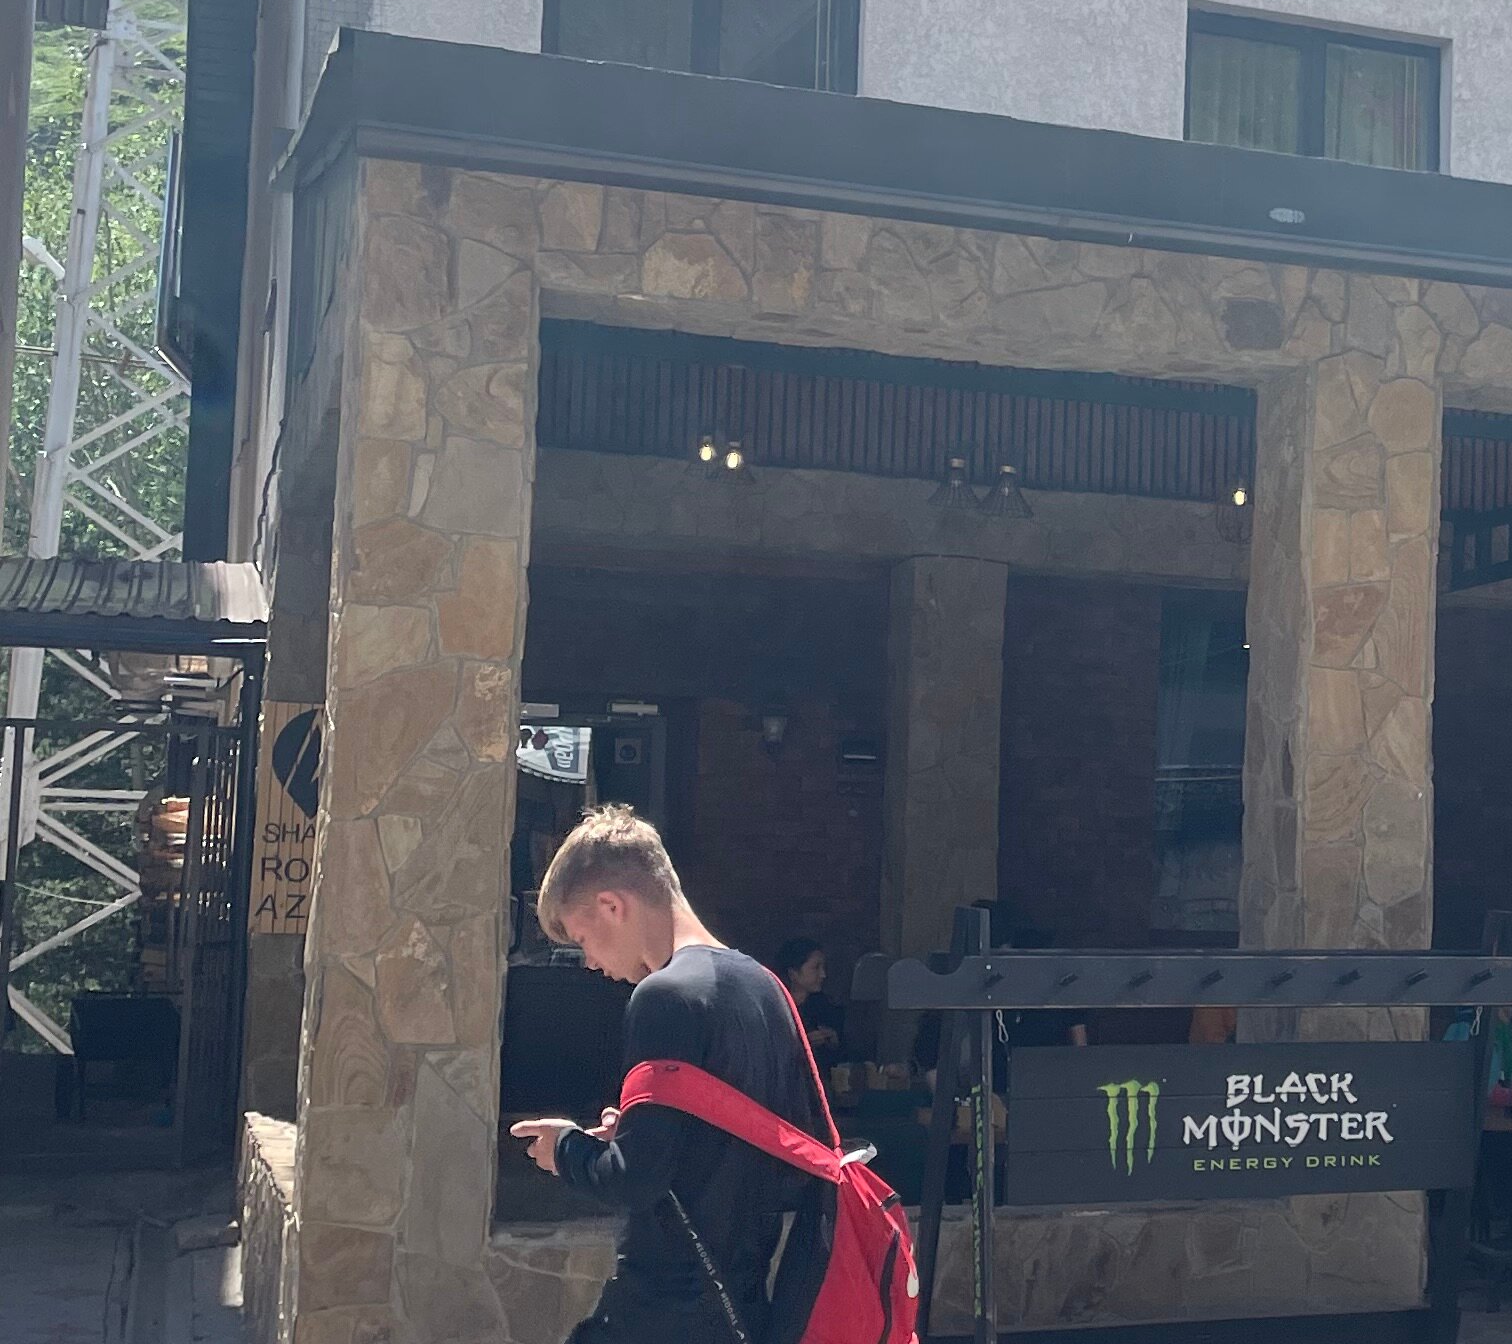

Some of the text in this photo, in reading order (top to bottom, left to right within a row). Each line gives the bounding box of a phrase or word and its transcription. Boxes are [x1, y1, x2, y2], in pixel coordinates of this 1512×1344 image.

[1226, 1072, 1358, 1107] BLACK
[1182, 1108, 1394, 1150] MONSTER
[1193, 1154, 1383, 1172] ENERGY DRINK
